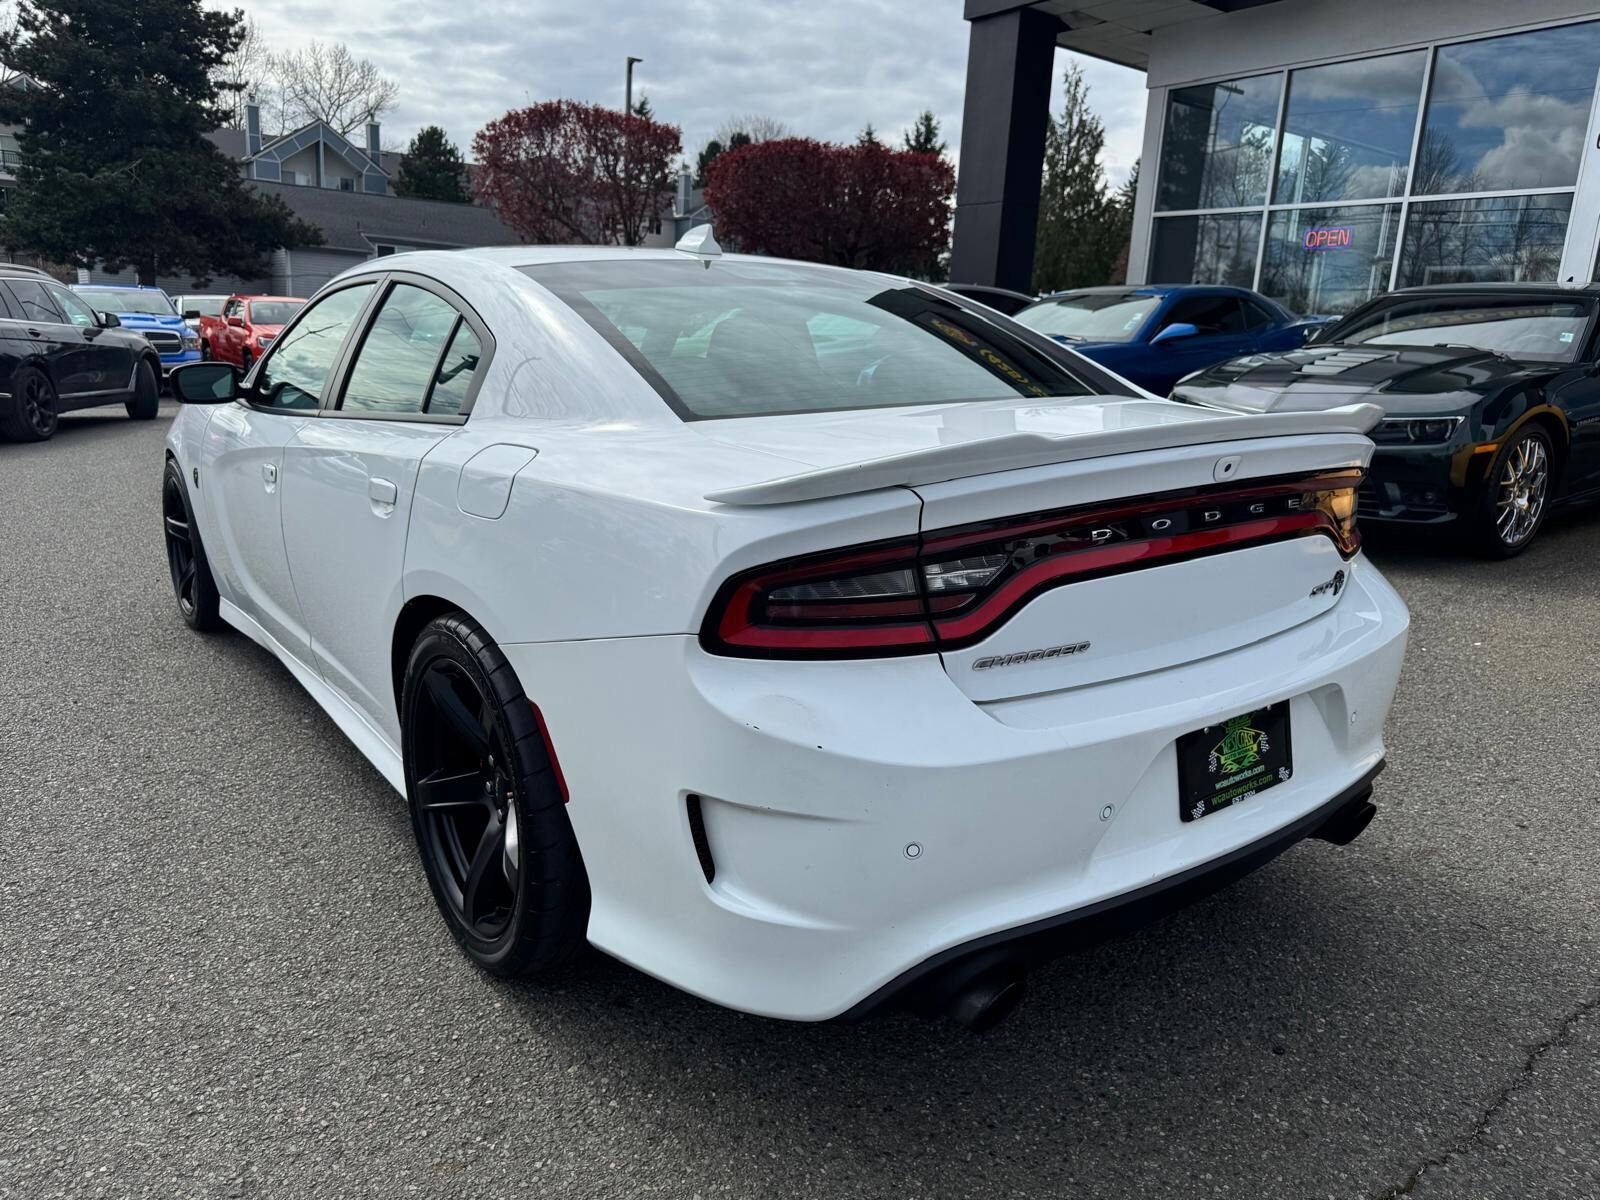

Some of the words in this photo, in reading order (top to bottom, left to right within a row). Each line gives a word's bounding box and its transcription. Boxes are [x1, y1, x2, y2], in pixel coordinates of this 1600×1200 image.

[1305, 229, 1350, 247] OPEN
[1091, 498, 1300, 541] DODGE
[972, 640, 1091, 671] CHARGER
[1211, 774, 1273, 806] wcautoworks.com
